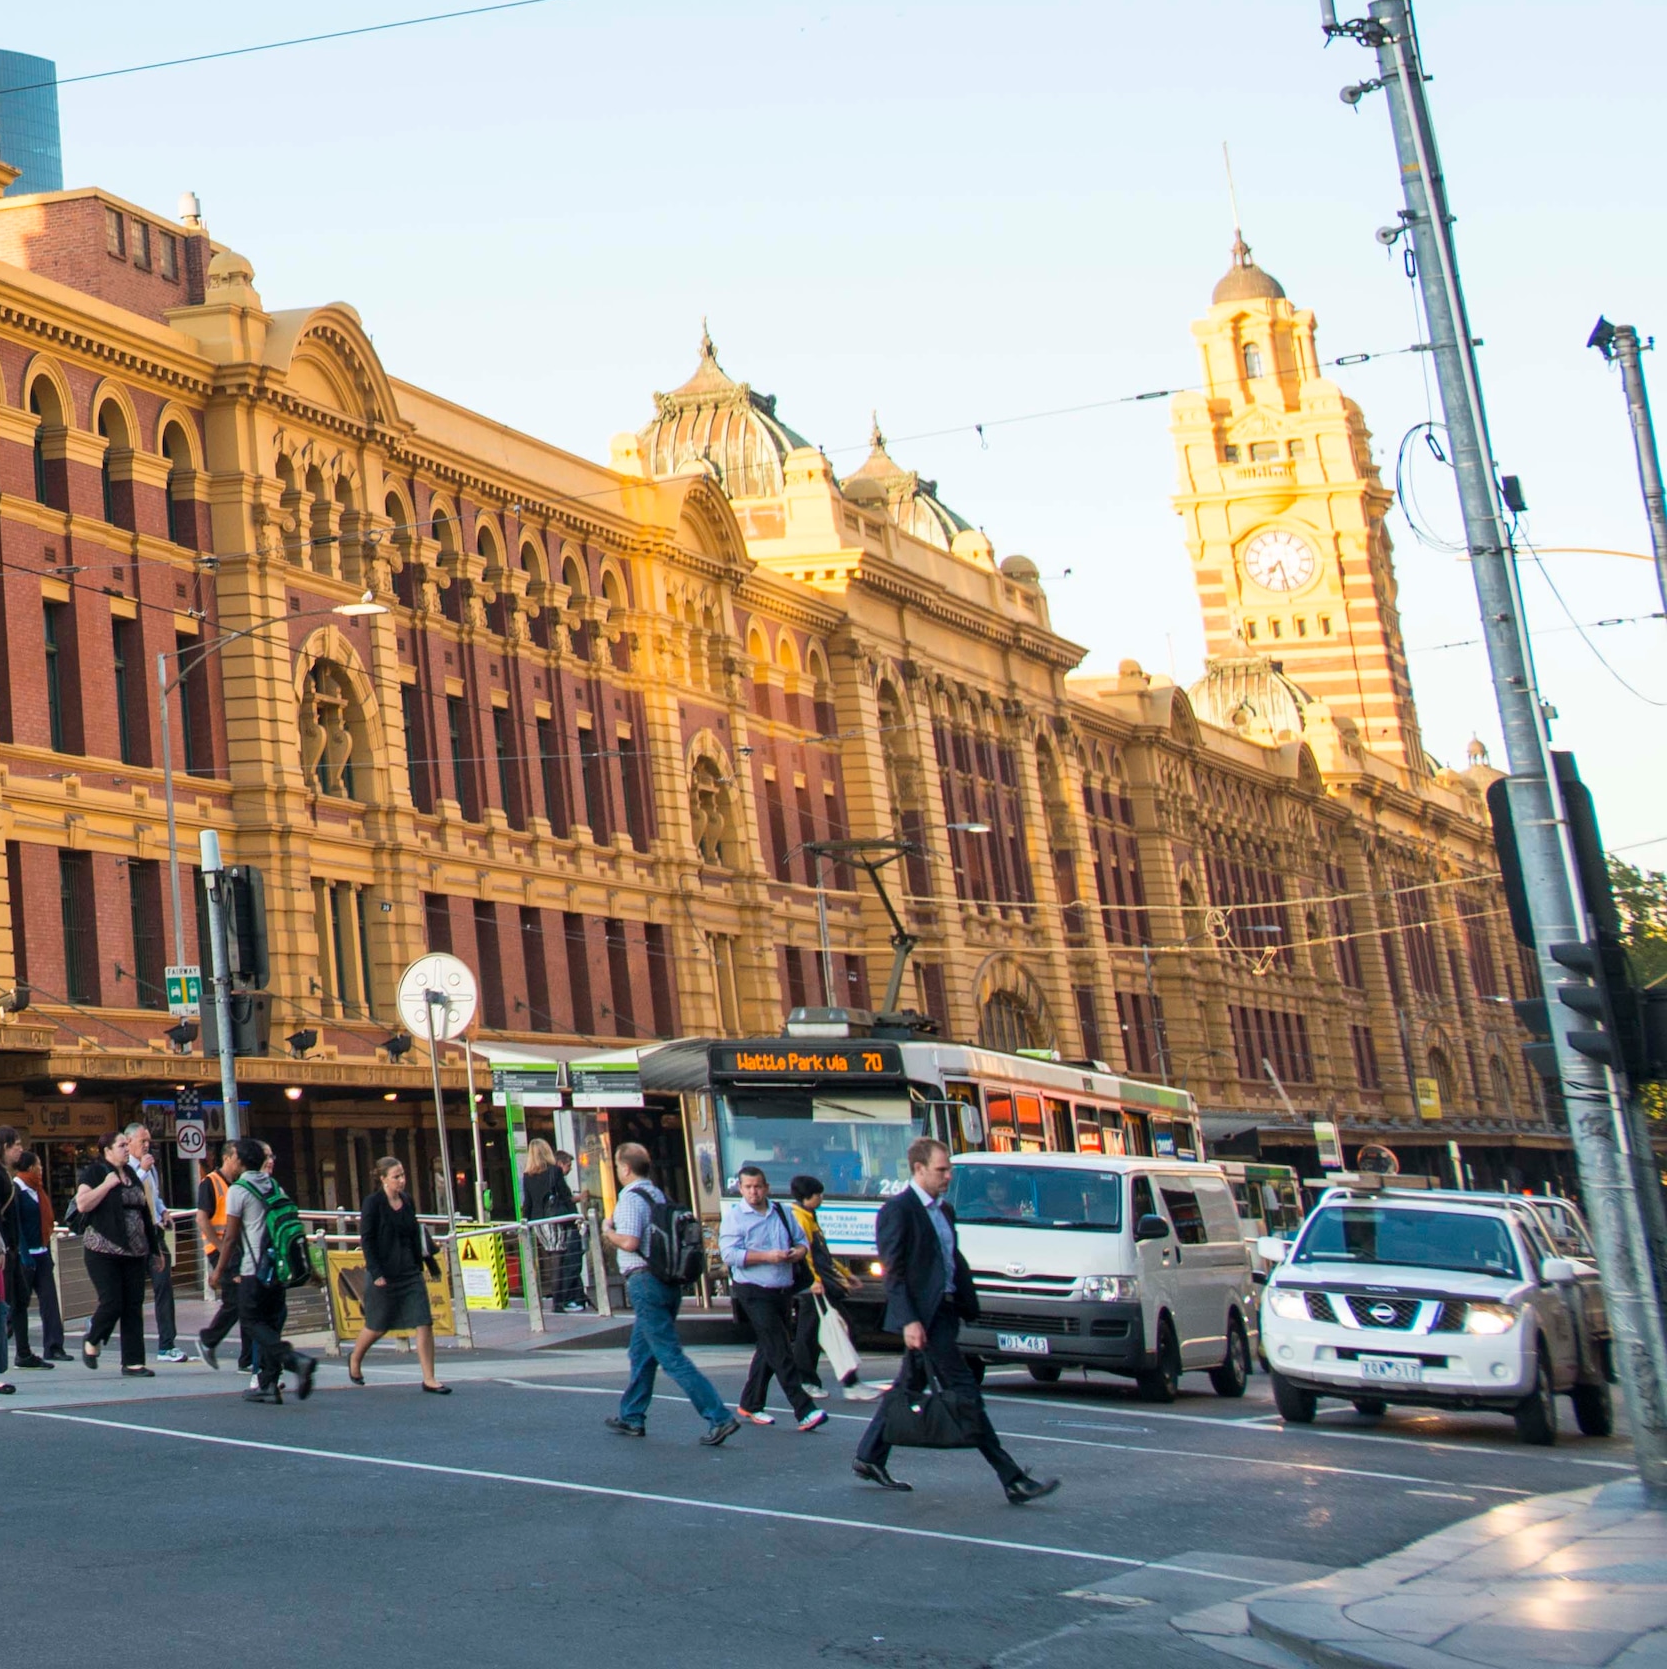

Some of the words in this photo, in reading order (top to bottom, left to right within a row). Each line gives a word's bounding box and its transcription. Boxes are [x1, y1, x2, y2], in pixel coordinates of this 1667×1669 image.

[167, 968, 197, 976] FAIRWAY
[736, 1052, 786, 1071] Wattle
[788, 1052, 824, 1071] Park
[826, 1054, 849, 1071] via
[862, 1052, 884, 1072] 70
[177, 1103, 199, 1112] Police
[179, 1131, 202, 1147] 40
